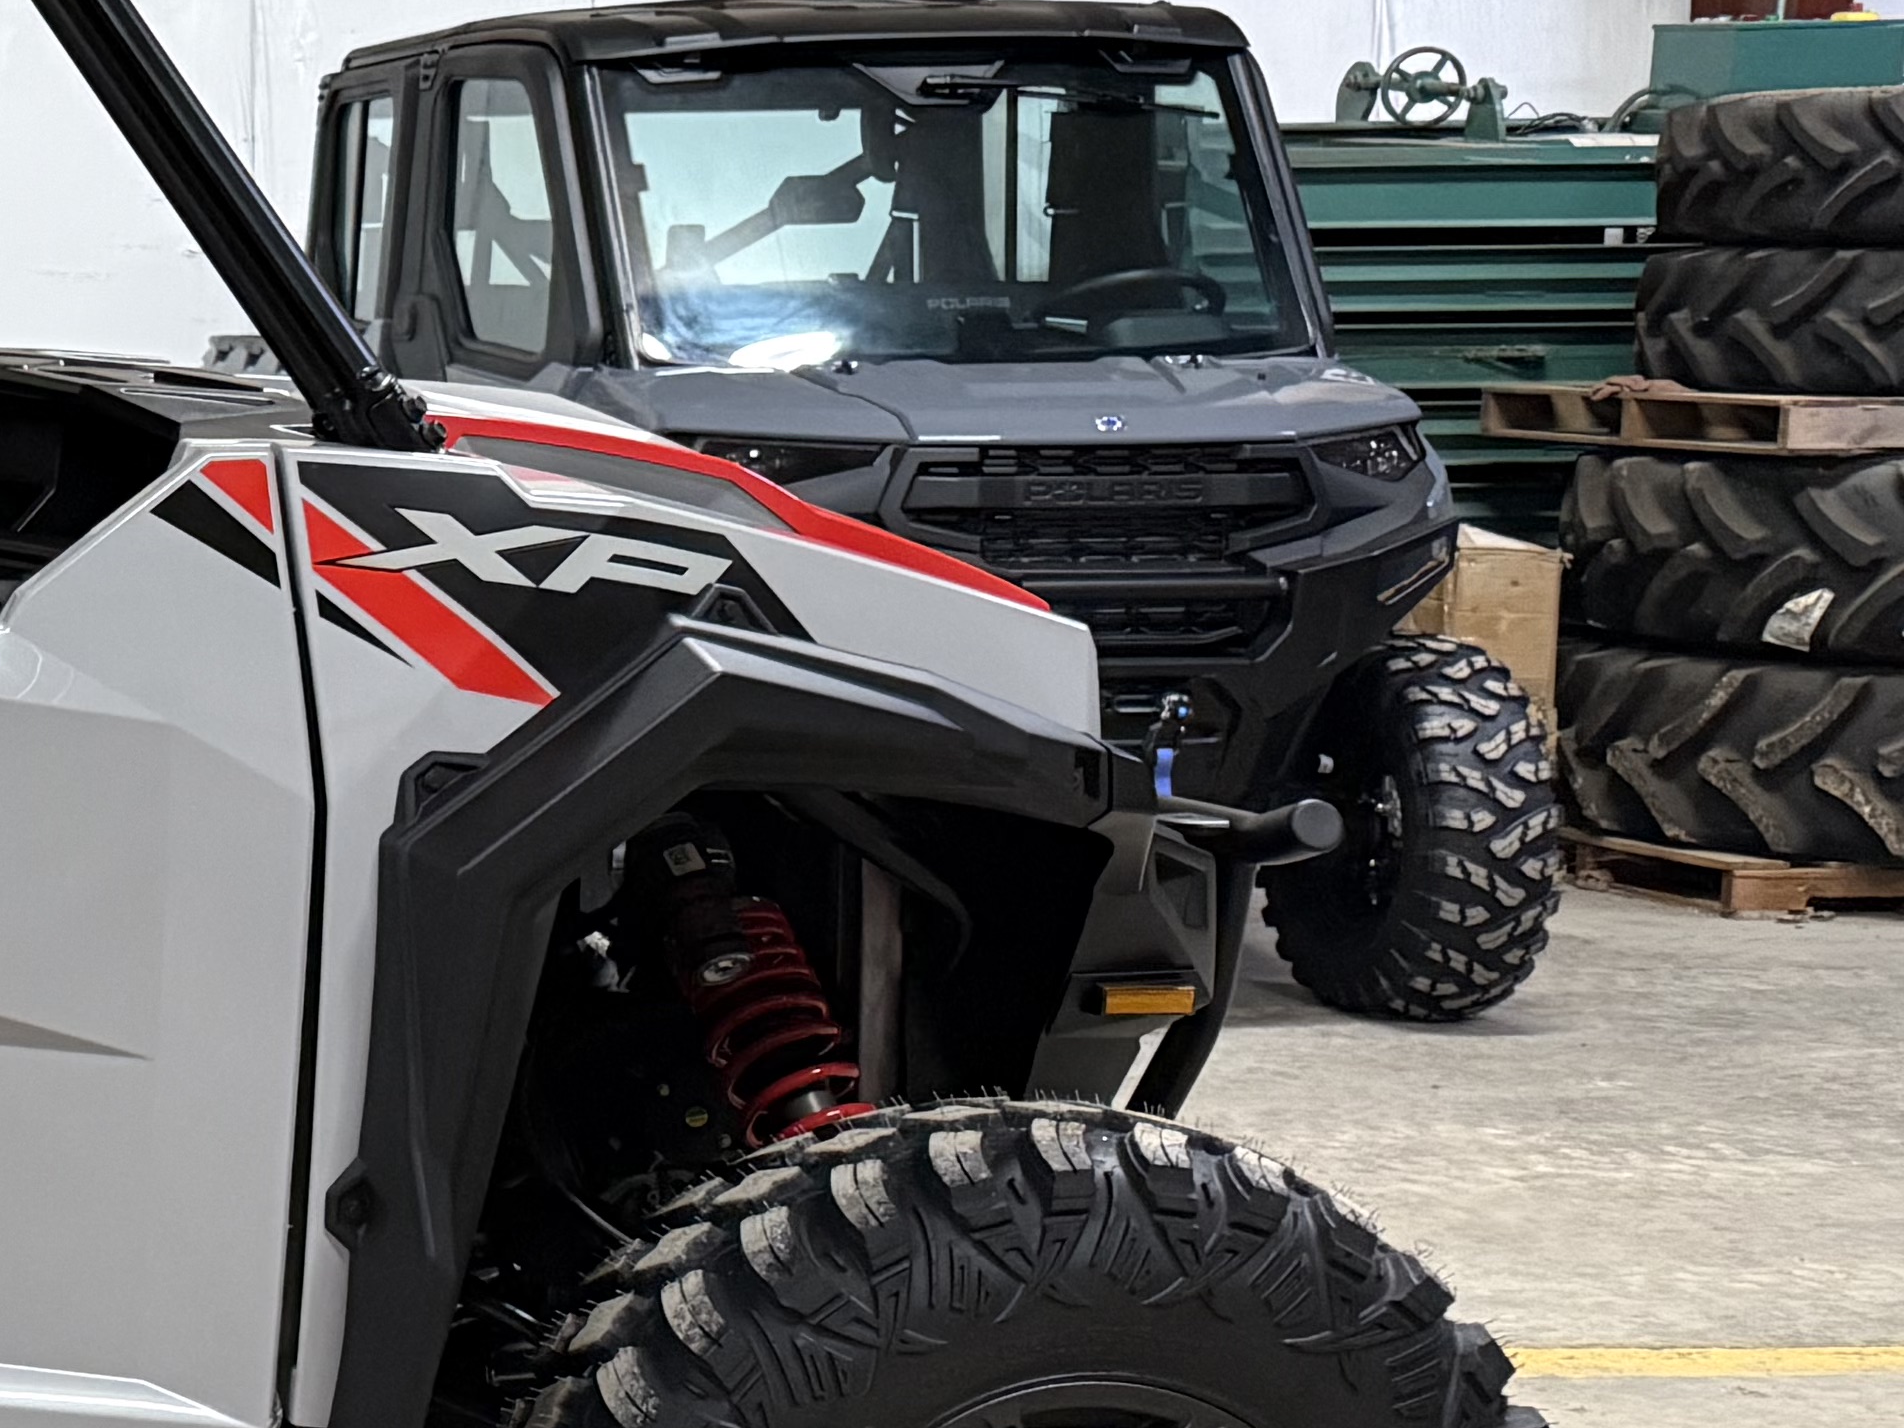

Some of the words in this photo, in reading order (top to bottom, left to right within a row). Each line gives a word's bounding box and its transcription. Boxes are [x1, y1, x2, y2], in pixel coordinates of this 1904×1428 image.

[927, 296, 1011, 310] POLARIS
[1024, 481, 1203, 504] POLARIS
[335, 506, 733, 595] XP
